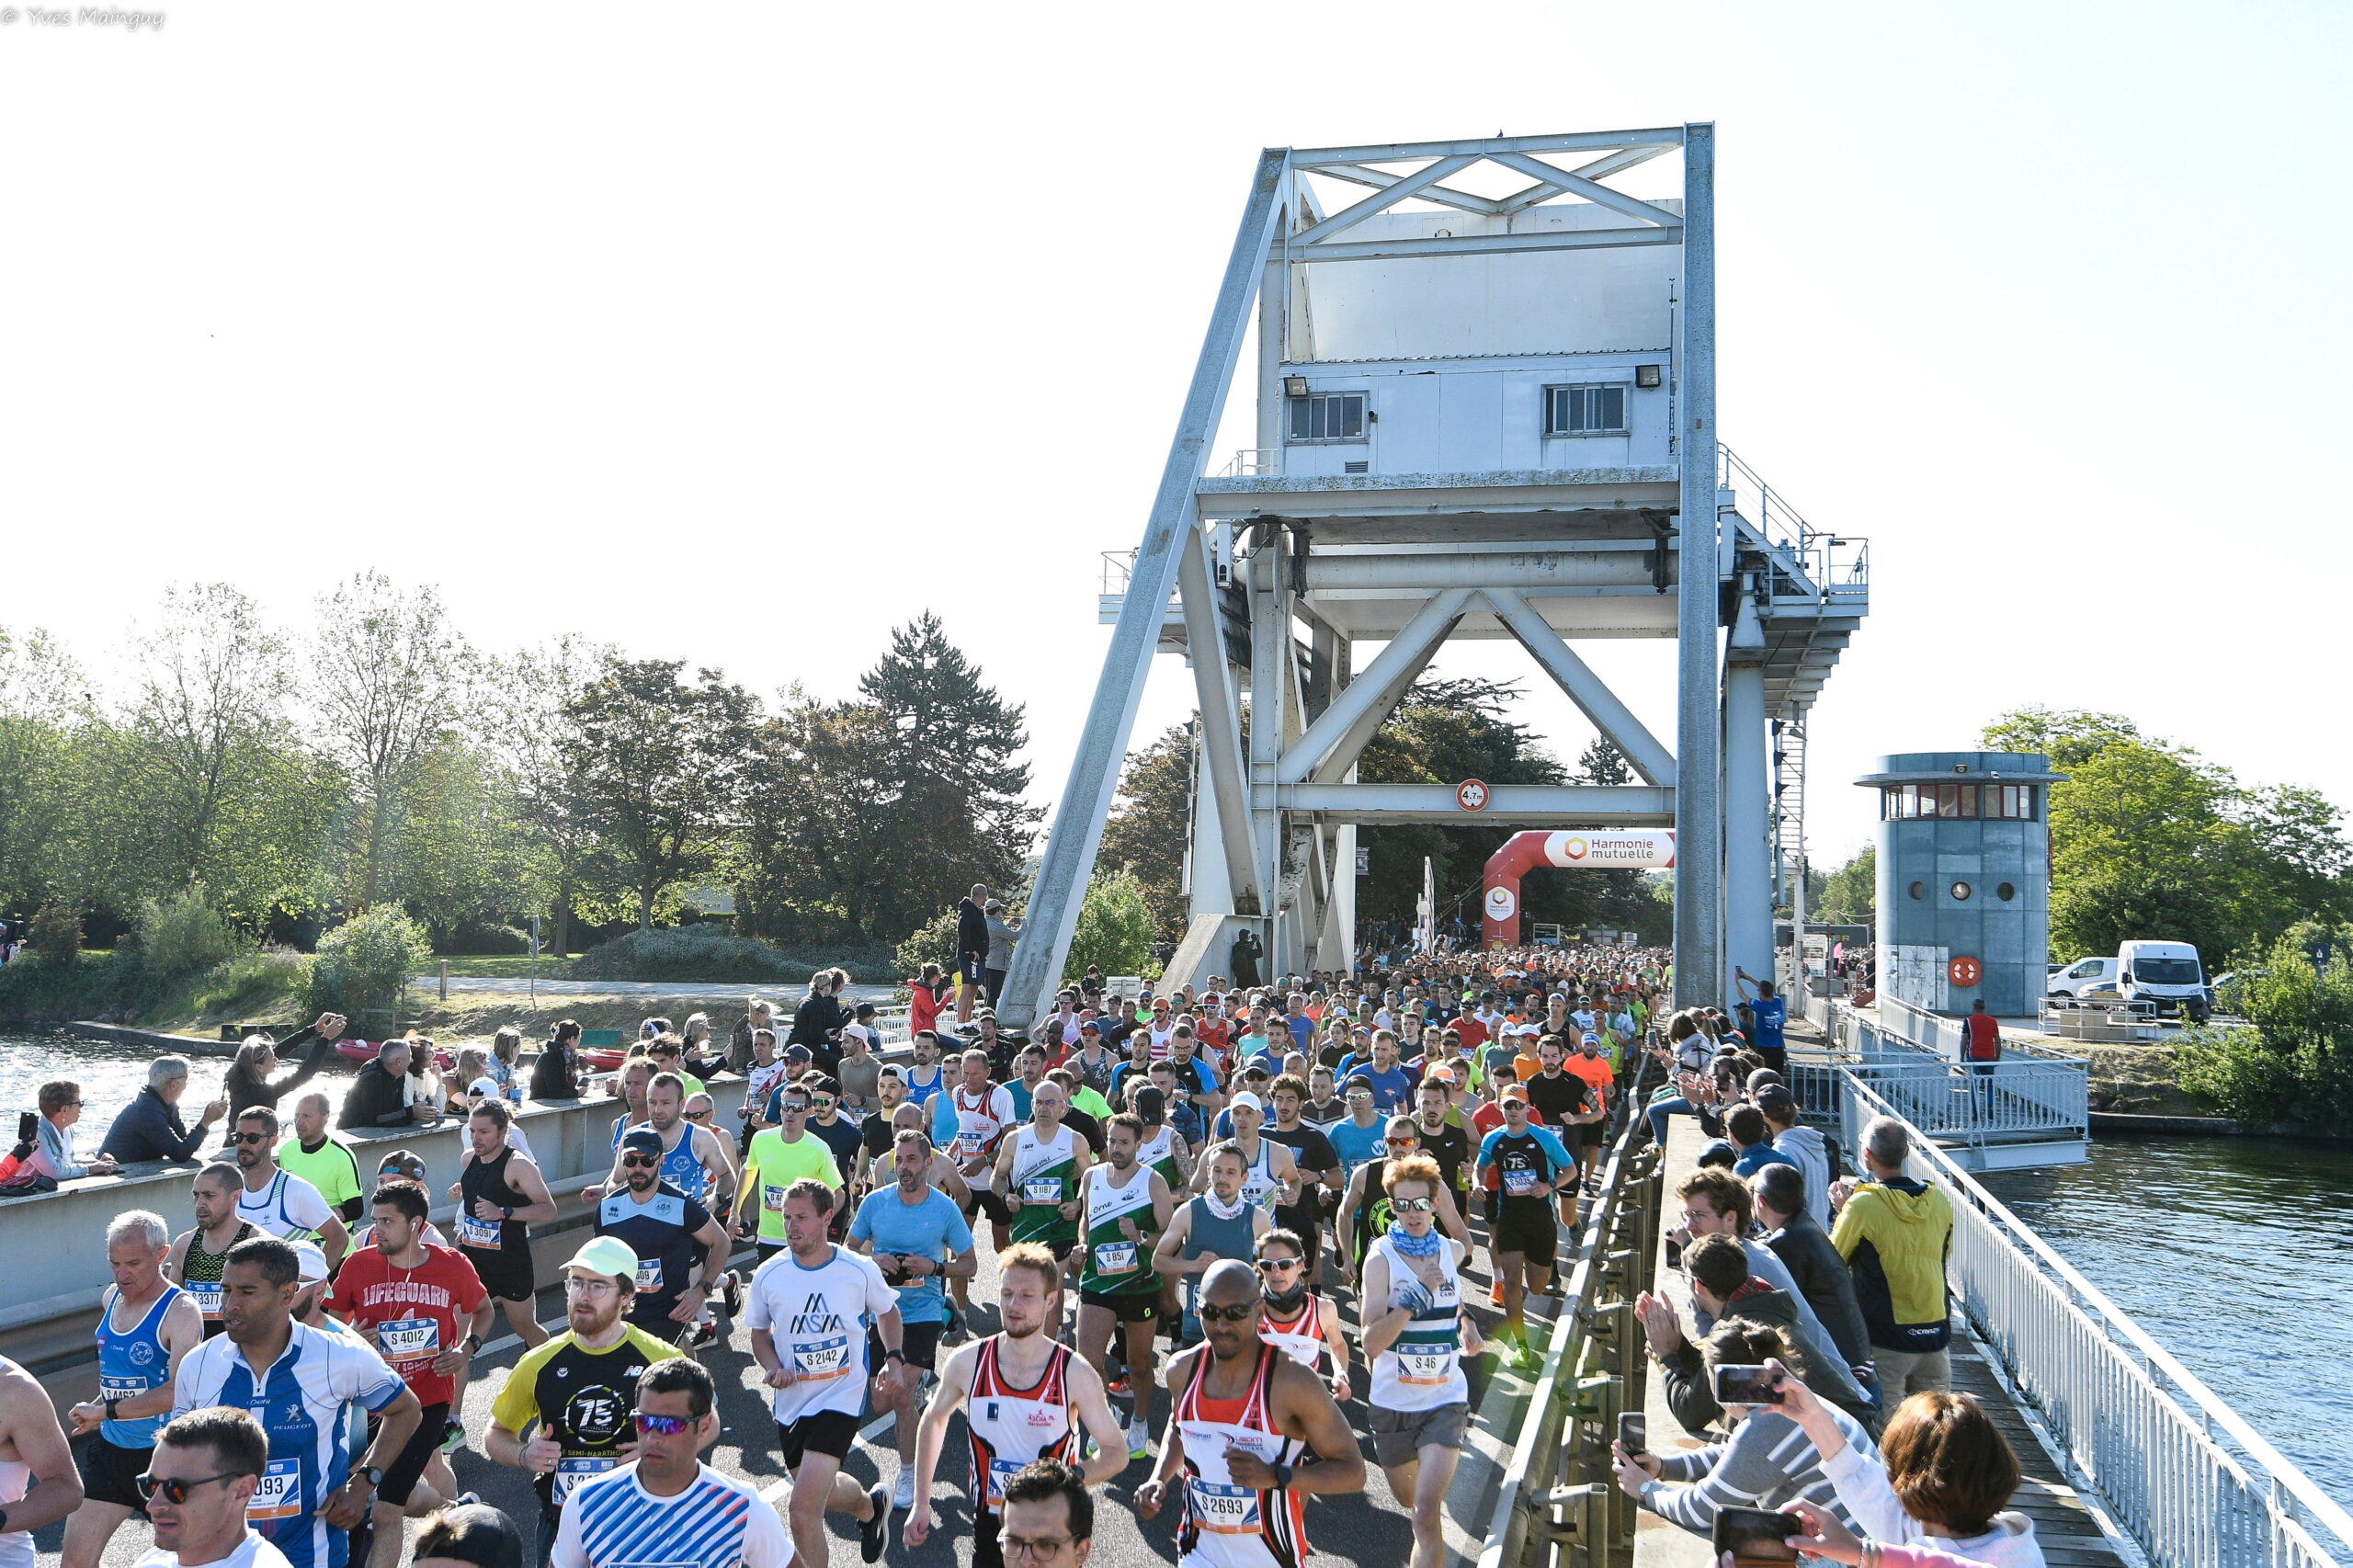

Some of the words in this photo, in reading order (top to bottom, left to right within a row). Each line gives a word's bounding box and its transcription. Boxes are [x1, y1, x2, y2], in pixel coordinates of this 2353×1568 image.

[1591, 838, 1654, 849] Harmonie
[1591, 850, 1654, 859] mutuelle
[1040, 1186, 1051, 1194] 1187
[469, 1226, 473, 1235] S
[474, 1227, 492, 1238] 3091
[1107, 1253, 1111, 1262] S
[1112, 1252, 1124, 1261] 851
[199, 1293, 220, 1305] 3377
[363, 1281, 450, 1308] LIFEGUARD
[392, 1333, 398, 1345] S
[400, 1329, 425, 1344] 4012
[807, 1354, 813, 1365] S
[815, 1349, 837, 1365] 2142
[1415, 1357, 1422, 1369] S
[1424, 1357, 1436, 1369] 46
[624, 1365, 644, 1377] NB
[576, 1399, 613, 1427] 75
[273, 1423, 313, 1431] PEUGEOT
[566, 1475, 574, 1491] S
[1201, 1495, 1209, 1510] S
[1211, 1498, 1244, 1514] 2693
